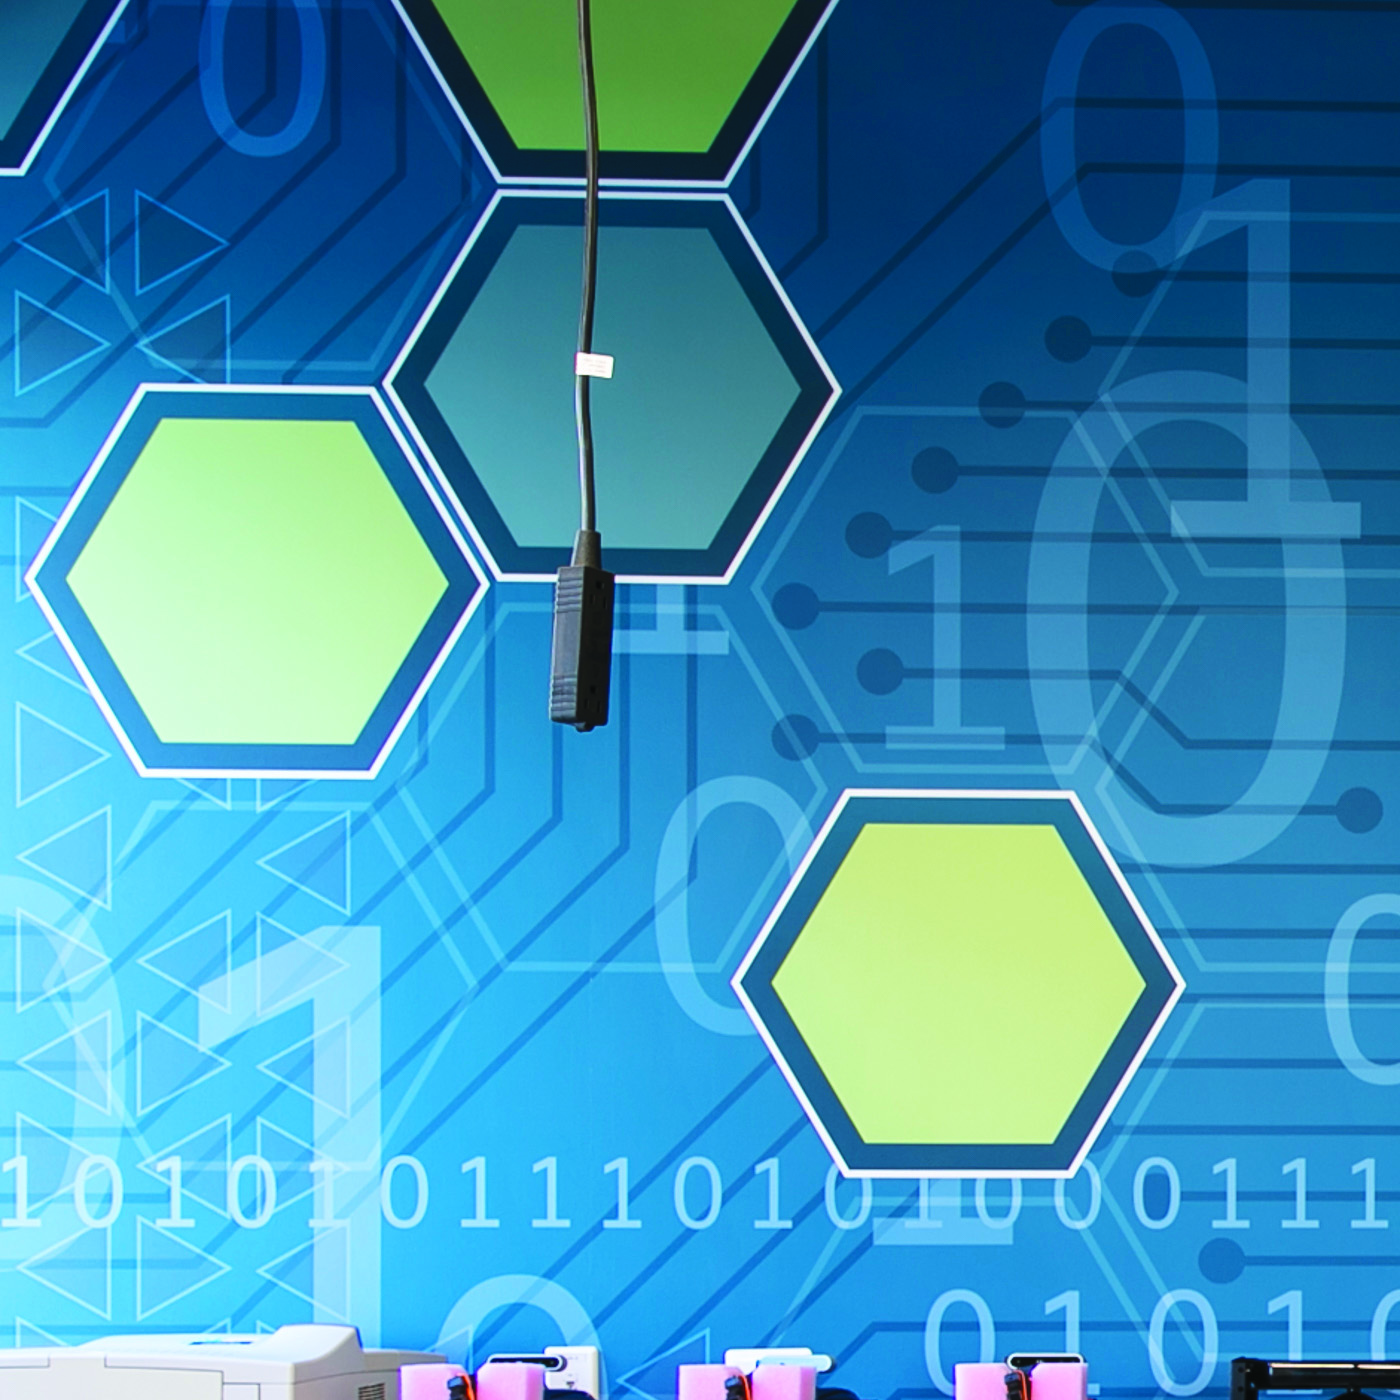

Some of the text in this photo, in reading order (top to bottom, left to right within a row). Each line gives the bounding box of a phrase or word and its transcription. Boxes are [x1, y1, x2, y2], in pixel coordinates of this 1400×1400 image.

[1040, 0, 1219, 275] 0
[1171, 178, 1362, 540] 1
[886, 525, 1006, 750] 1
[1026, 369, 1348, 868] 0
